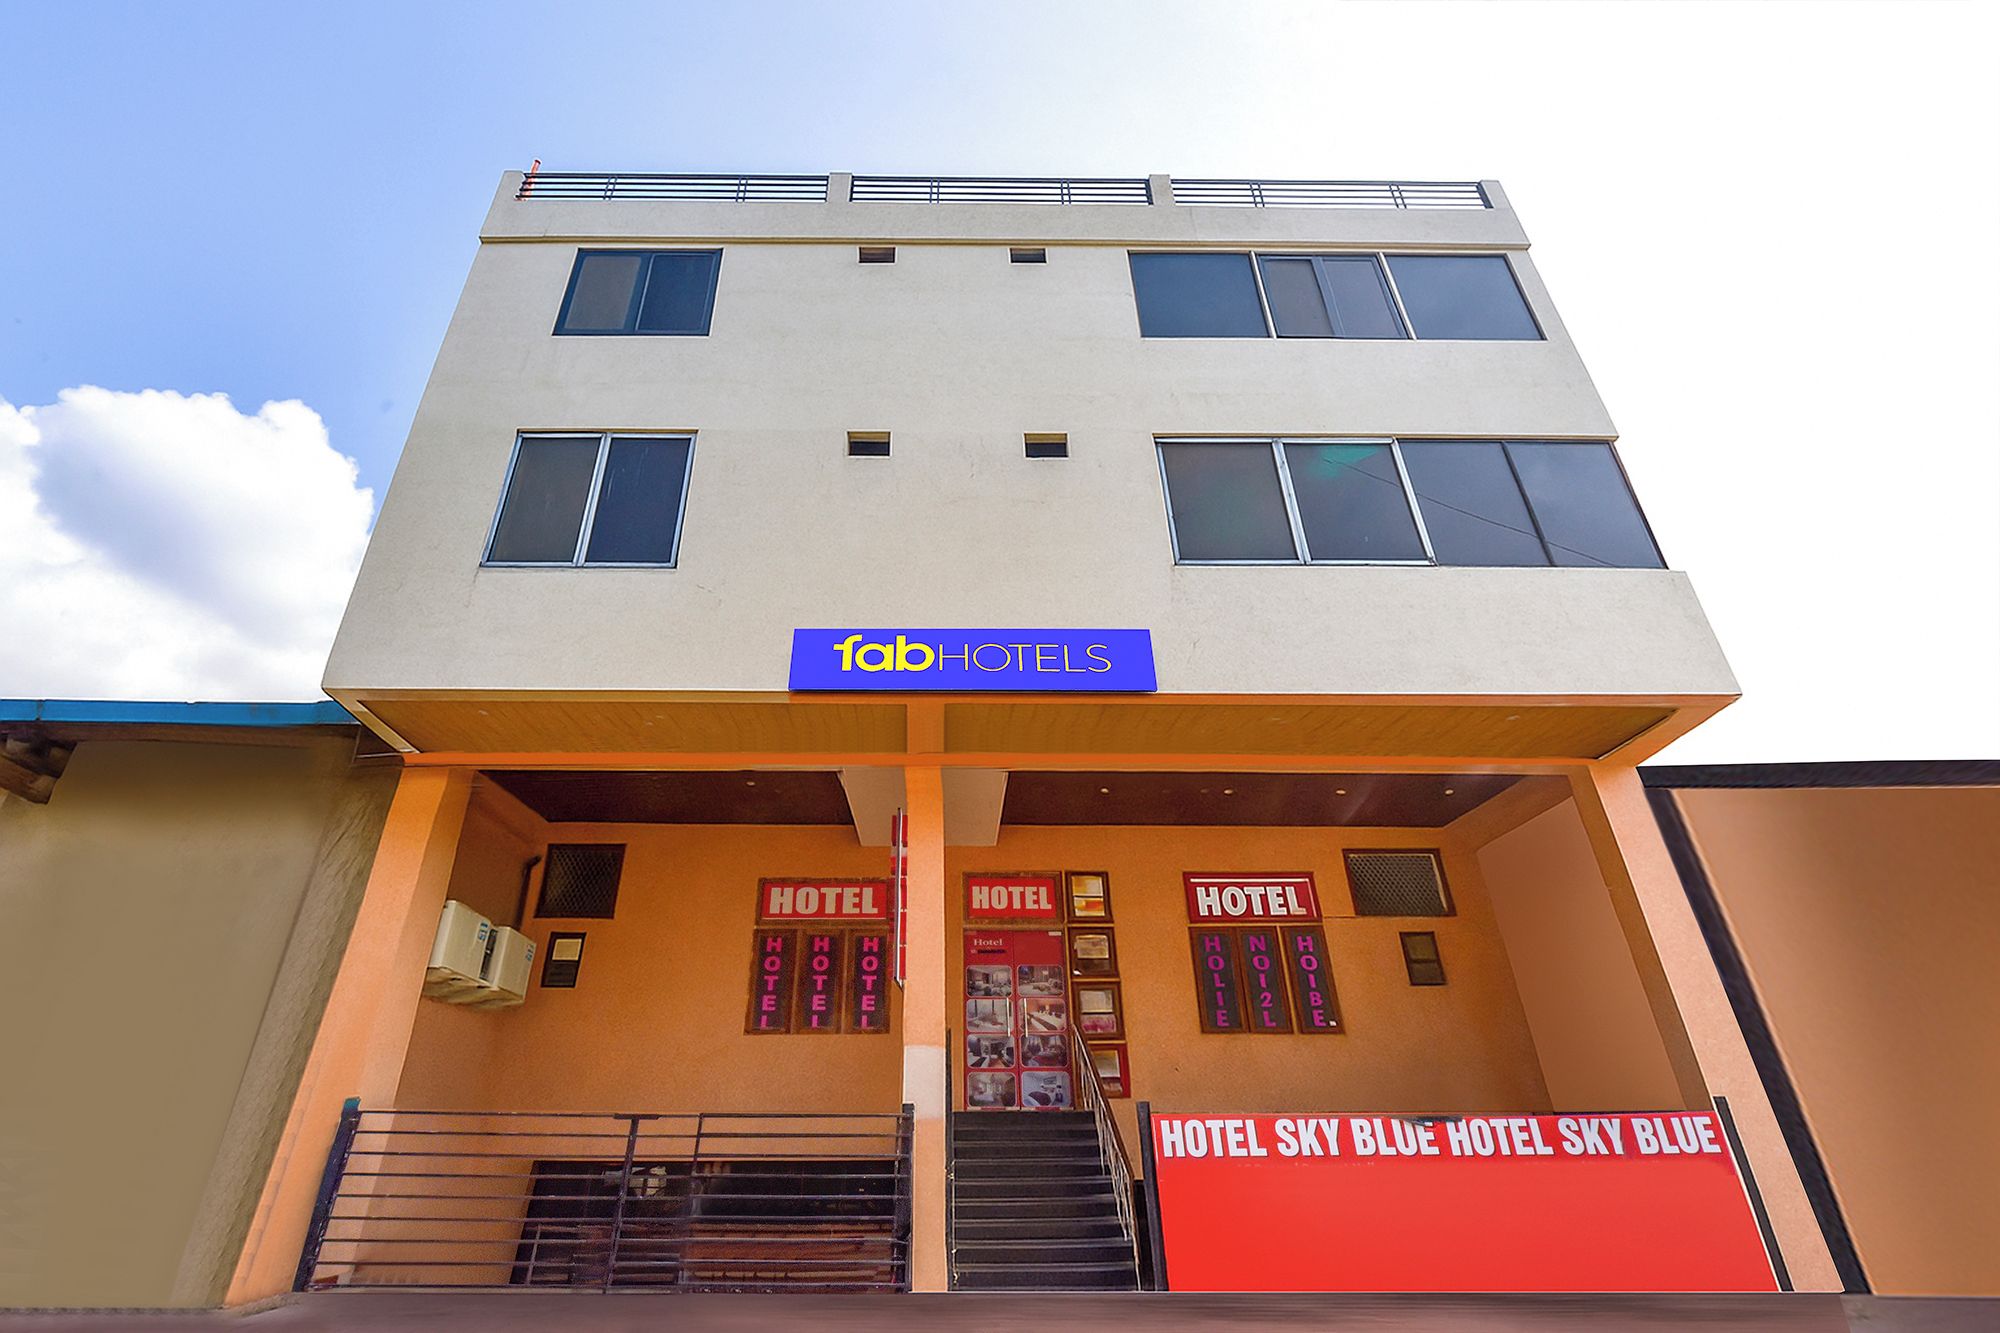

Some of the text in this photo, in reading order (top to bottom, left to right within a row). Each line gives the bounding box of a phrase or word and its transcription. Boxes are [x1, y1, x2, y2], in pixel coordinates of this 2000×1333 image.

[833, 633, 1112, 673] fabHOTELS
[769, 887, 878, 914] HOTEL
[972, 886, 1052, 910] HOTEL
[1196, 886, 1307, 916] HOTEL
[973, 938, 1003, 946] Hotel
[760, 937, 783, 1029] HOTEL
[811, 937, 830, 1029] HOTEL
[861, 937, 879, 1029] HOTEL
[1161, 1116, 1721, 1158] HOTEL SKY BLUE HOTEL SKY BLUE
